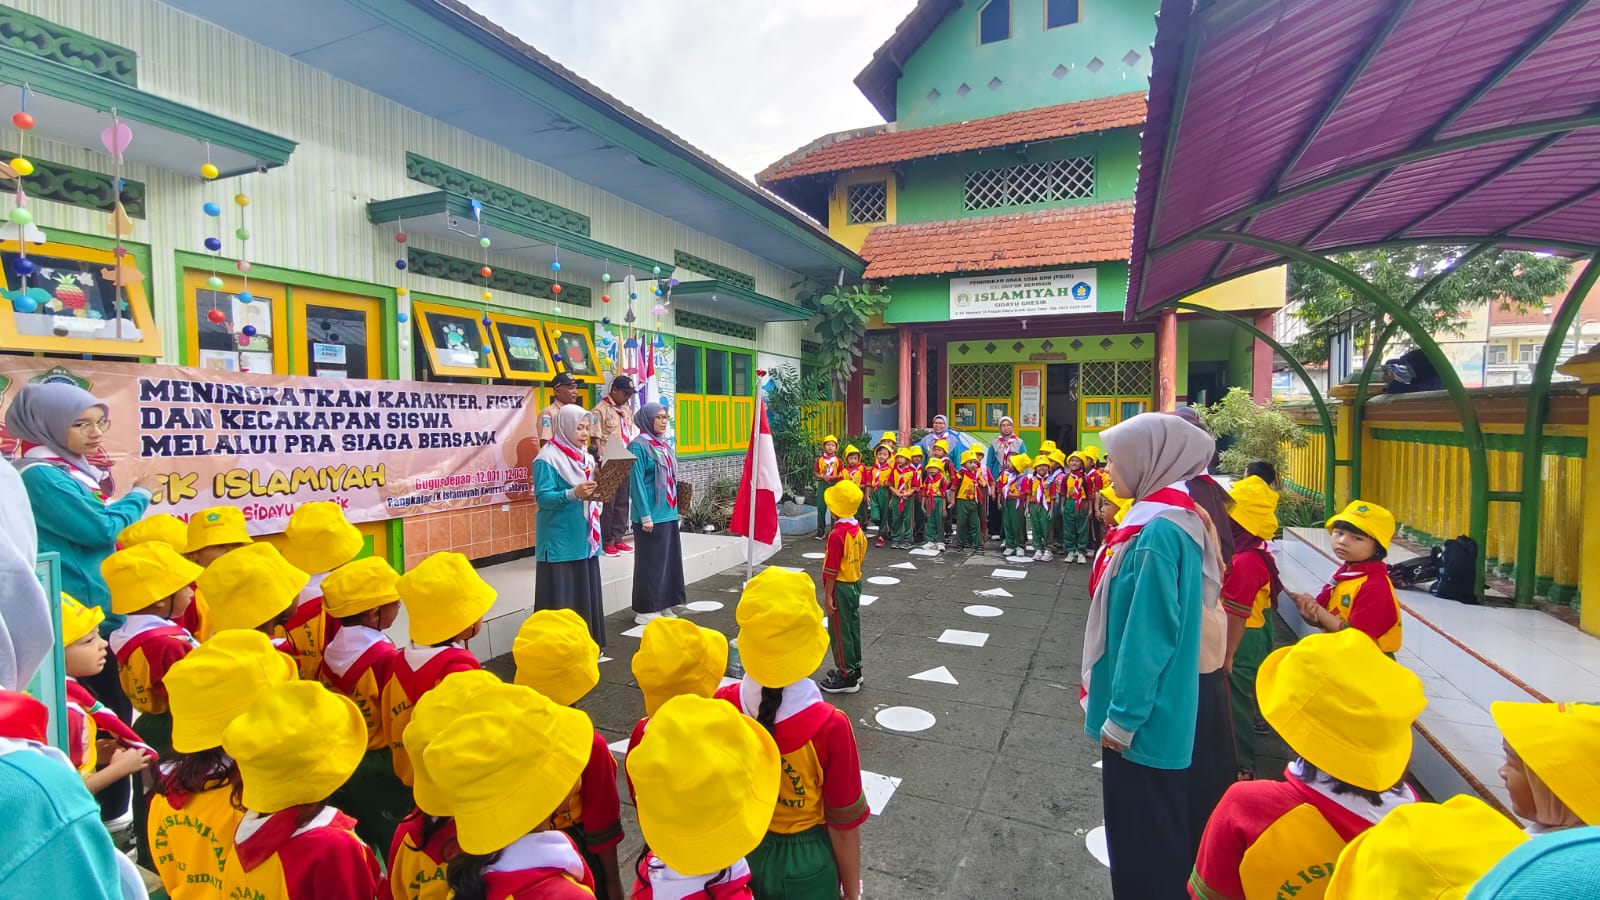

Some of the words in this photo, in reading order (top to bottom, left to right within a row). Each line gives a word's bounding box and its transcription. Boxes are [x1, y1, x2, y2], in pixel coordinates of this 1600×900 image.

[974, 287, 1069, 302] ISLAMIYAH
[139, 379, 372, 408] MENINGKATKAN
[377, 390, 483, 411] KARAKTER,
[486, 395, 525, 410] FISIK
[140, 407, 214, 430] DAN
[219, 409, 381, 430] KECAKAPAN
[387, 412, 453, 429] SISWA
[140, 434, 277, 457] MELALUI
[284, 434, 336, 453] PRA
[341, 432, 413, 452] SIAGA
[418, 430, 497, 449] BERSAMA
[213, 463, 386, 499] ISLAMIYAH
[443, 487, 479, 500] Islamiyah
